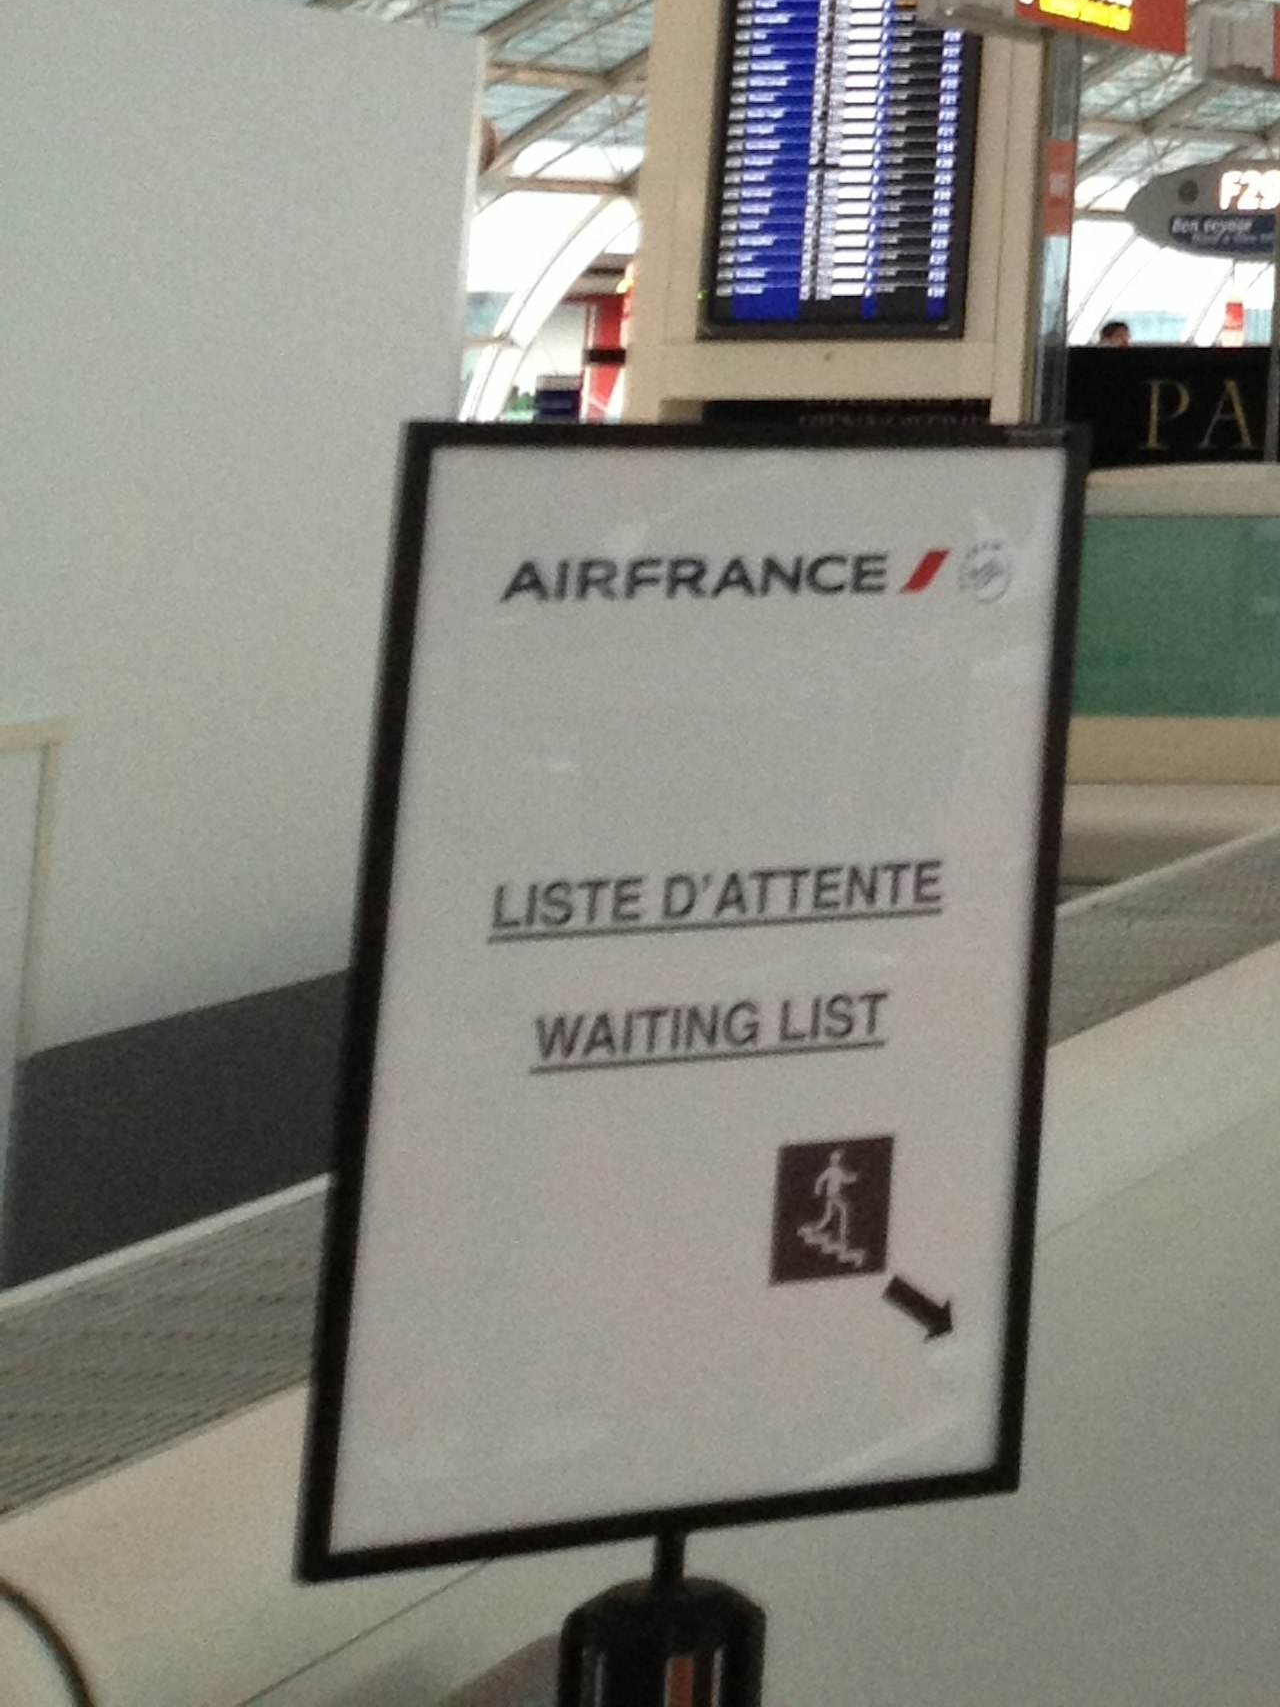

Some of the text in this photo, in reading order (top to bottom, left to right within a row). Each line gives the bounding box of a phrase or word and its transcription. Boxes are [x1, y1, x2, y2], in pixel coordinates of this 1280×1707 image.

[500, 550, 889, 604] AIRFRANCE
[492, 859, 943, 929] LISTE D'ATTENTE
[534, 991, 889, 1060] WAITING LIST
